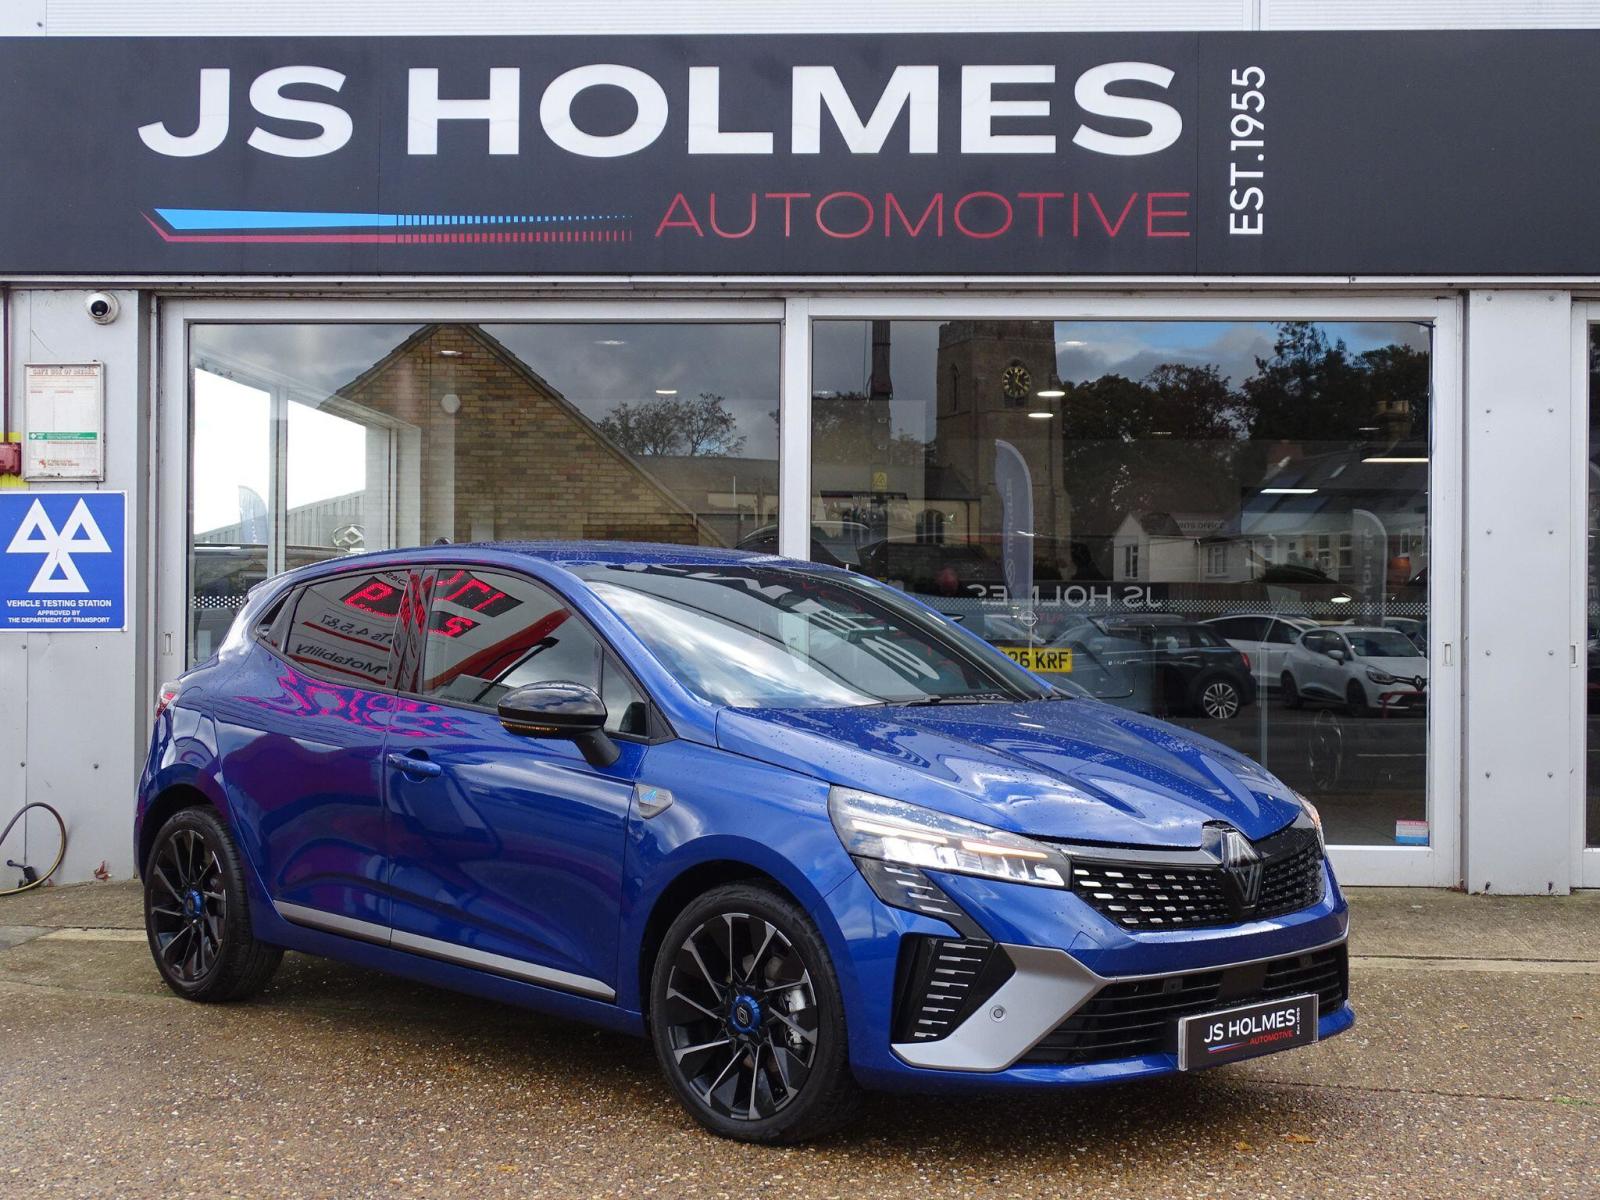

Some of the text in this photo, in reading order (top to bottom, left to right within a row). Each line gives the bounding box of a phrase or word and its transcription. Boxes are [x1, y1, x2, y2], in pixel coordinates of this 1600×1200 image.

[137, 61, 1183, 158] JS HOLMES
[1229, 65, 1266, 236] EST.1955
[654, 190, 1191, 240] AUTOMOTIVE
[6, 599, 112, 607] VEHICLE TESTING STATION
[1035, 651, 1069, 669] KRF
[1203, 1008, 1296, 1043] JS HOLMES
[1249, 1029, 1294, 1046] AUTOMOTIVE
